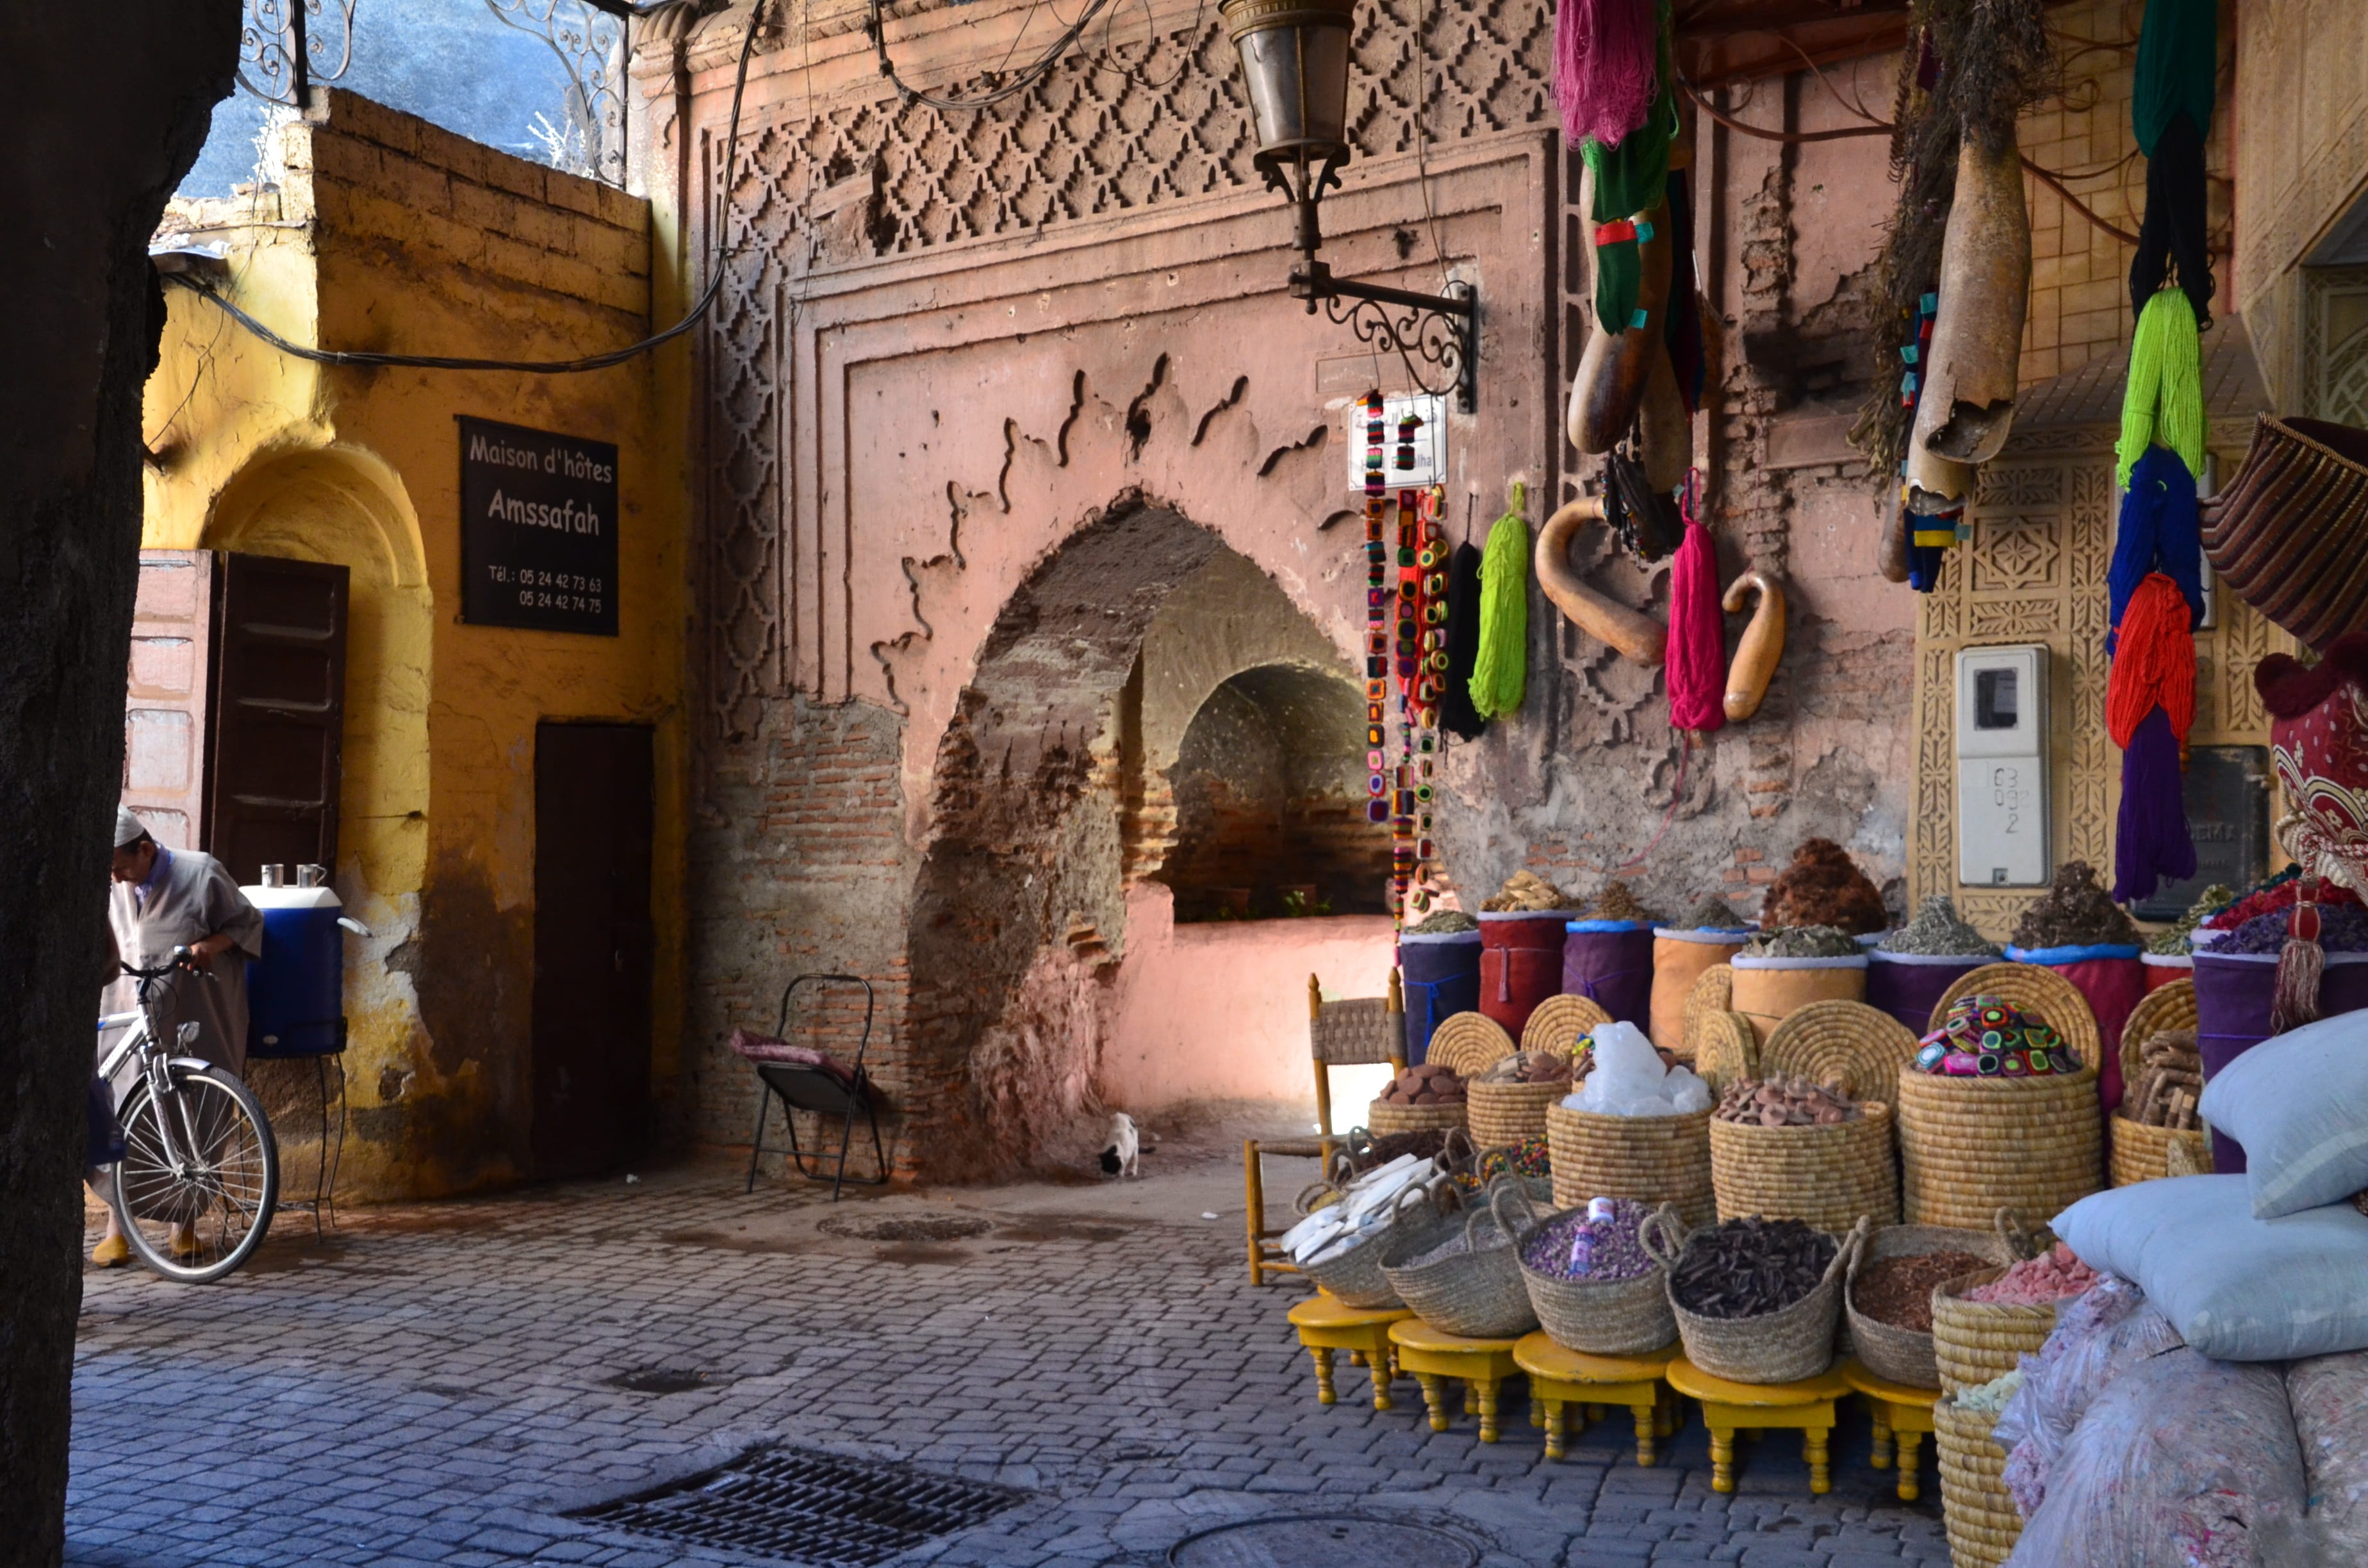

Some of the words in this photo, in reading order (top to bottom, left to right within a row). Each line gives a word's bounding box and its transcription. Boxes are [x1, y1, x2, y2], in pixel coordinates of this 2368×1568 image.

[470, 434, 538, 470] Maison
[545, 448, 613, 484] d'hôtes
[488, 488, 600, 535] Amssafah
[520, 569, 534, 584] 05
[538, 571, 551, 586] 24
[555, 574, 569, 588] 42
[573, 576, 585, 591] 73
[589, 578, 602, 592] 63
[520, 590, 534, 606] 05
[538, 592, 551, 607] 24
[555, 594, 568, 608] 42
[572, 596, 585, 610] 74
[589, 598, 601, 613] 75
[2005, 813, 2019, 834] 2
